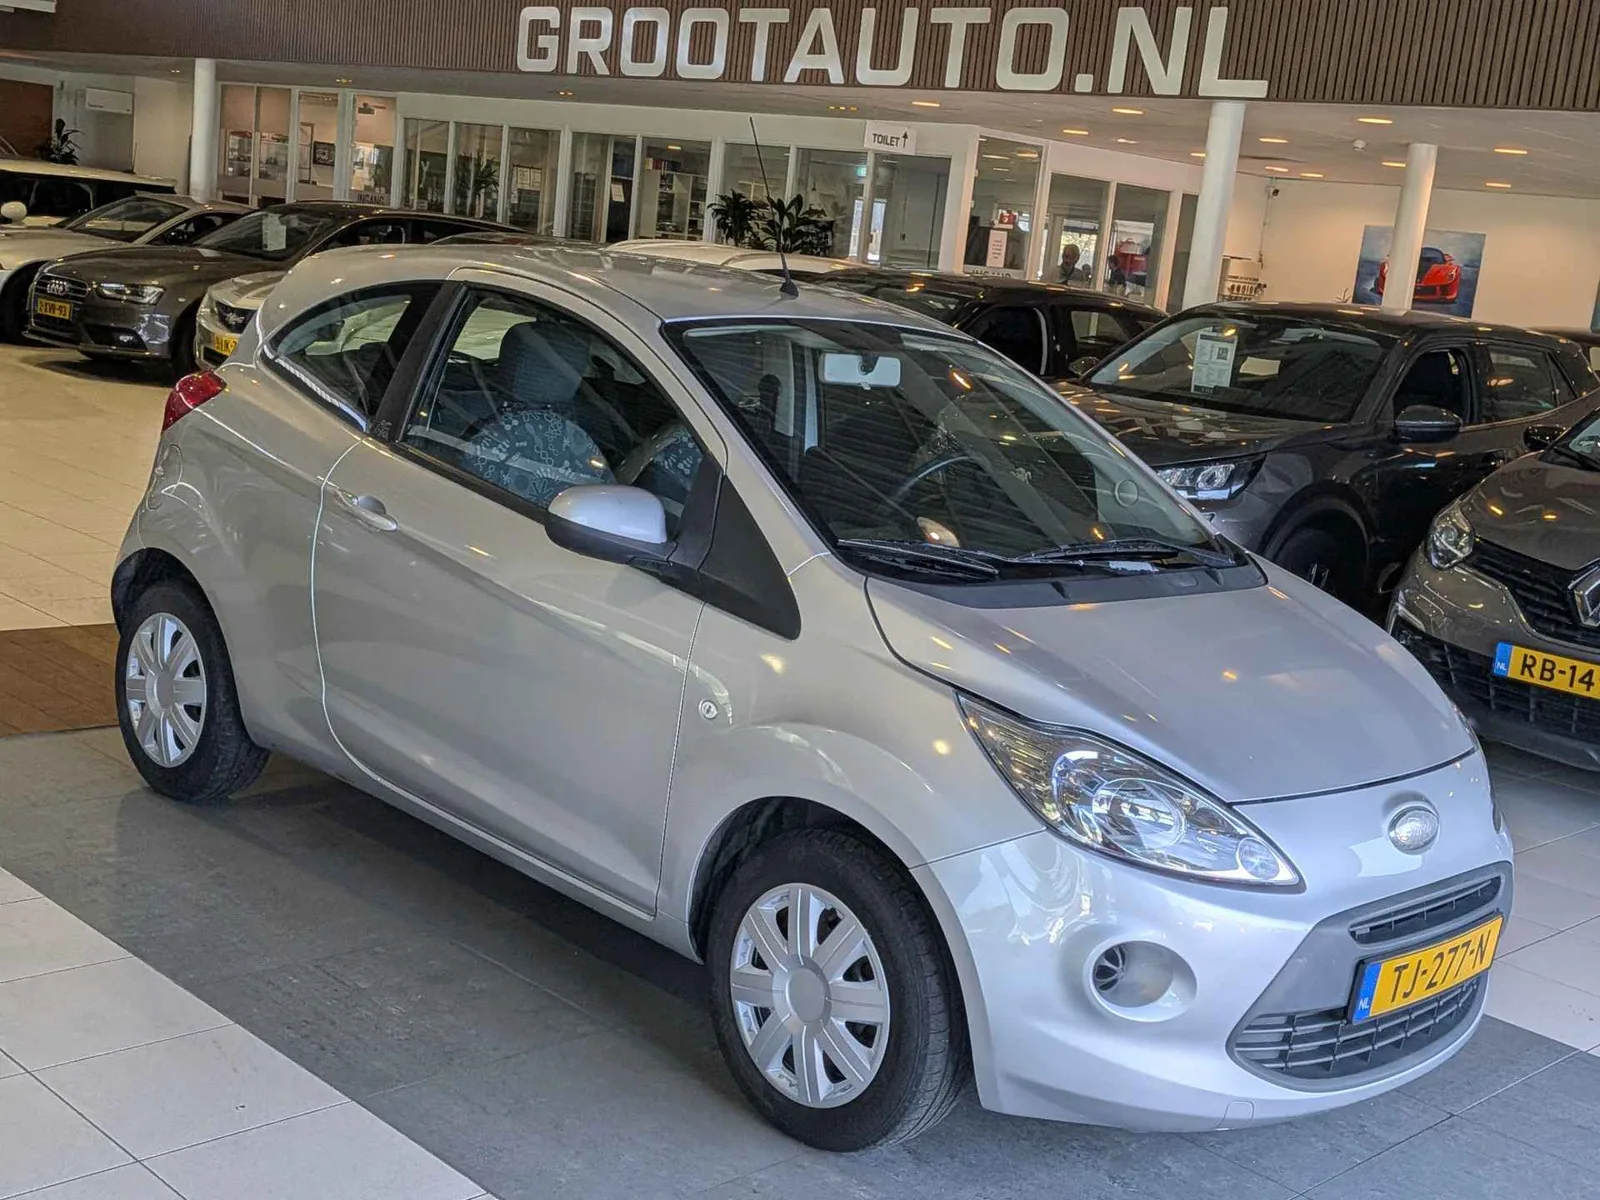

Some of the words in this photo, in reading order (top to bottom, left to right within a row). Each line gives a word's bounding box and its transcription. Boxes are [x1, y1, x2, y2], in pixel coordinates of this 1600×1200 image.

[517, 6, 1269, 98] GROOTAUTO.NL
[872, 133, 901, 148] TOILET
[1496, 661, 1507, 671] NL
[1358, 999, 1370, 1010] NL
[1391, 929, 1492, 1003] TJ-277-N
